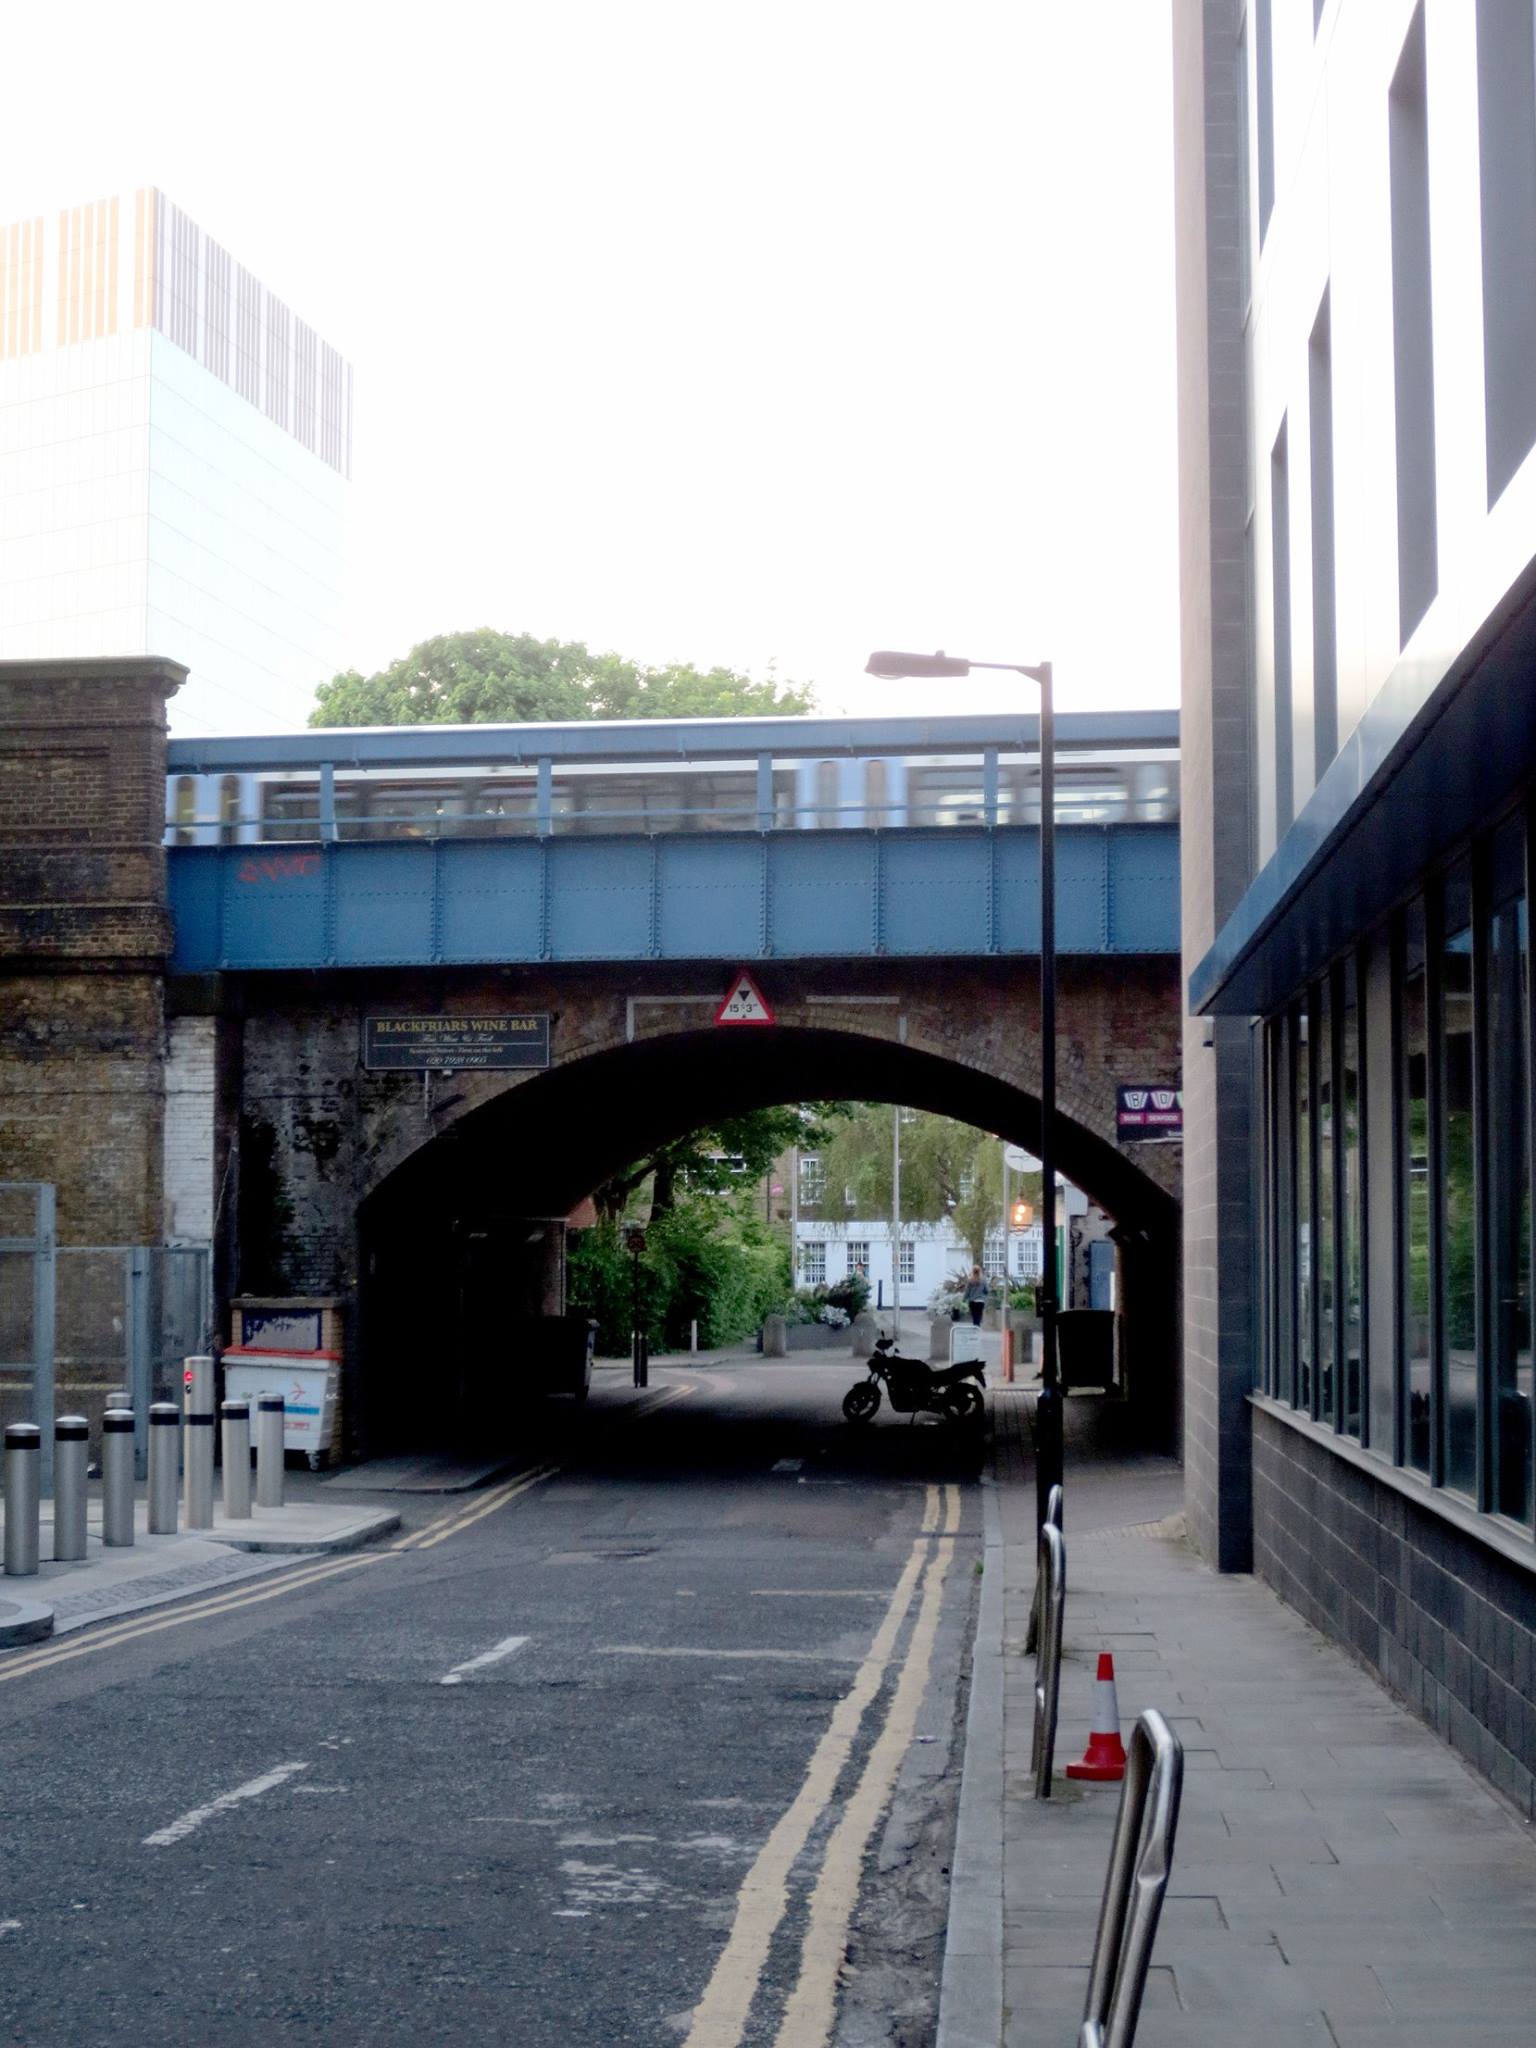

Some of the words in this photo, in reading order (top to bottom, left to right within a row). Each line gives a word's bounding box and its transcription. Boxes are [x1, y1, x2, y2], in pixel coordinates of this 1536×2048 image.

[377, 1020, 468, 1032] BLACKFRIARS
[471, 1020, 507, 1031] WINE
[511, 1019, 537, 1031] BAR
